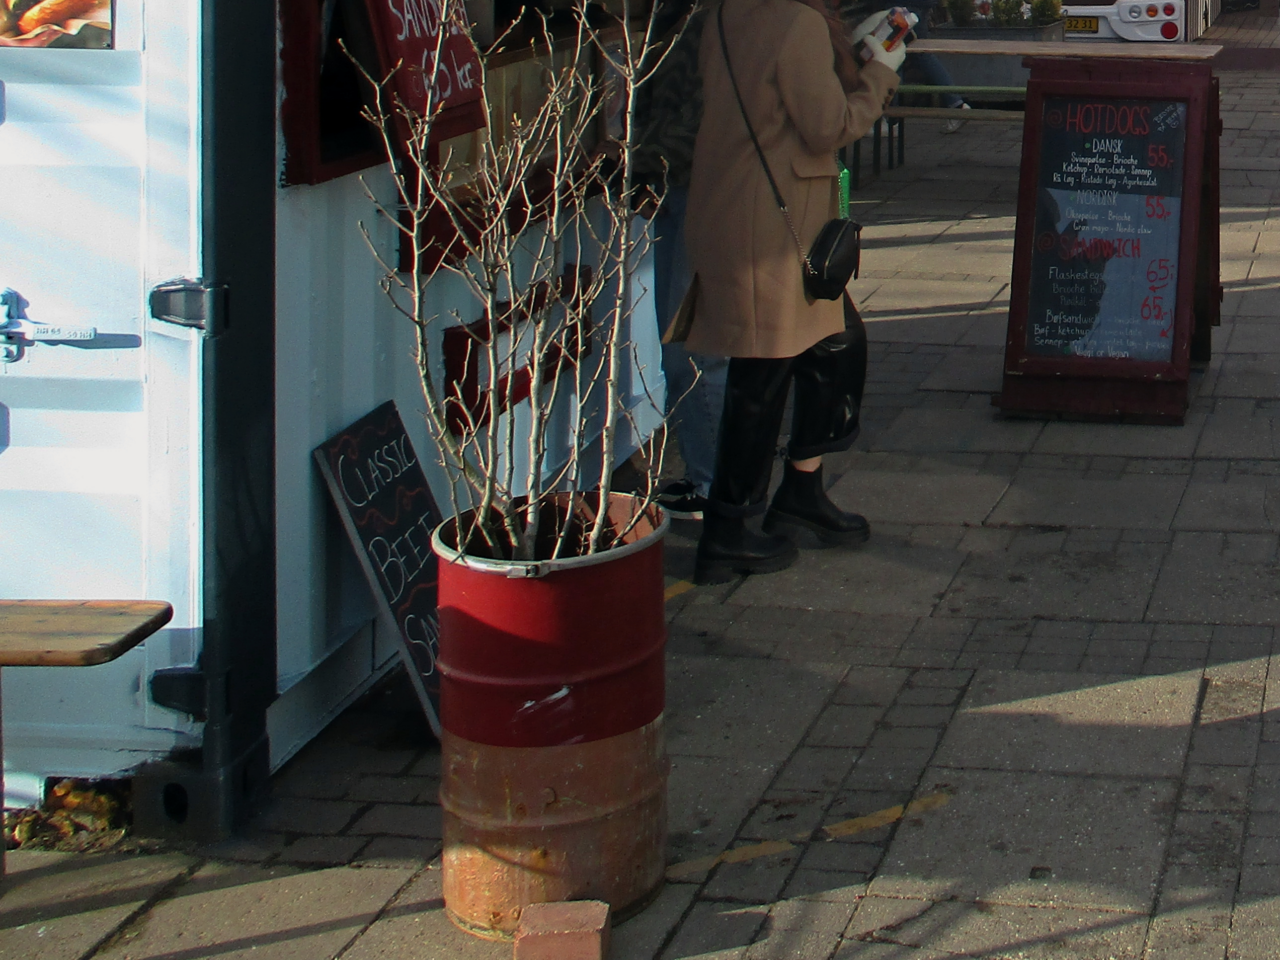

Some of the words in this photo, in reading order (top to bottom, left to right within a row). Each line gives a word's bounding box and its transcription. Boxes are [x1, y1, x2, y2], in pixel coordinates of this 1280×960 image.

[1067, 19, 1079, 29] 32
[1081, 19, 1093, 29] 31
[1066, 103, 1150, 135] HOTDOGS
[1092, 138, 1123, 153] DANSK
[1113, 154, 1138, 165] Brioche
[1062, 162, 1088, 178] Ketchup
[1076, 189, 1119, 206] NORDISK
[1058, 235, 1141, 259] SANDWICH
